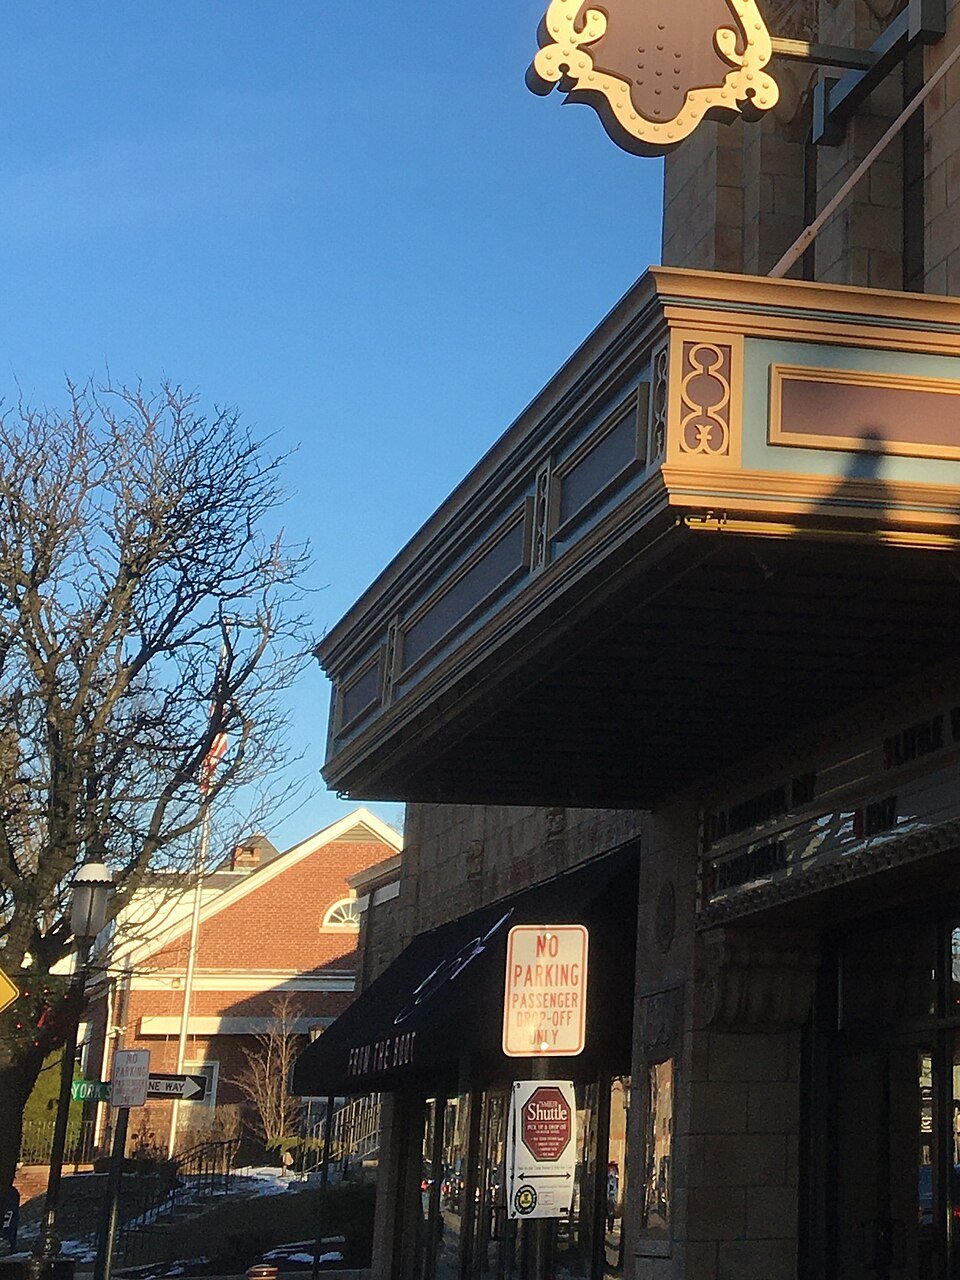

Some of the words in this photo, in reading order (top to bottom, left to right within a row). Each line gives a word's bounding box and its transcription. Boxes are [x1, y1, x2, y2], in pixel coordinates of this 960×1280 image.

[535, 934, 559, 958] NO
[513, 963, 579, 987] PARKING
[512, 993, 578, 1008] PASSENGER
[515, 1011, 573, 1027] DROP-OFF
[529, 1029, 559, 1045] ONLY
[126, 1053, 138, 1064] NO
[373, 1040, 389, 1071] THE
[393, 1031, 417, 1069] BOOT
[116, 1066, 147, 1078] PARKING
[71, 1083, 101, 1099] YORK
[148, 1081, 161, 1090] NE
[165, 1081, 185, 1092] WAY
[527, 1103, 567, 1121] Shuttle
